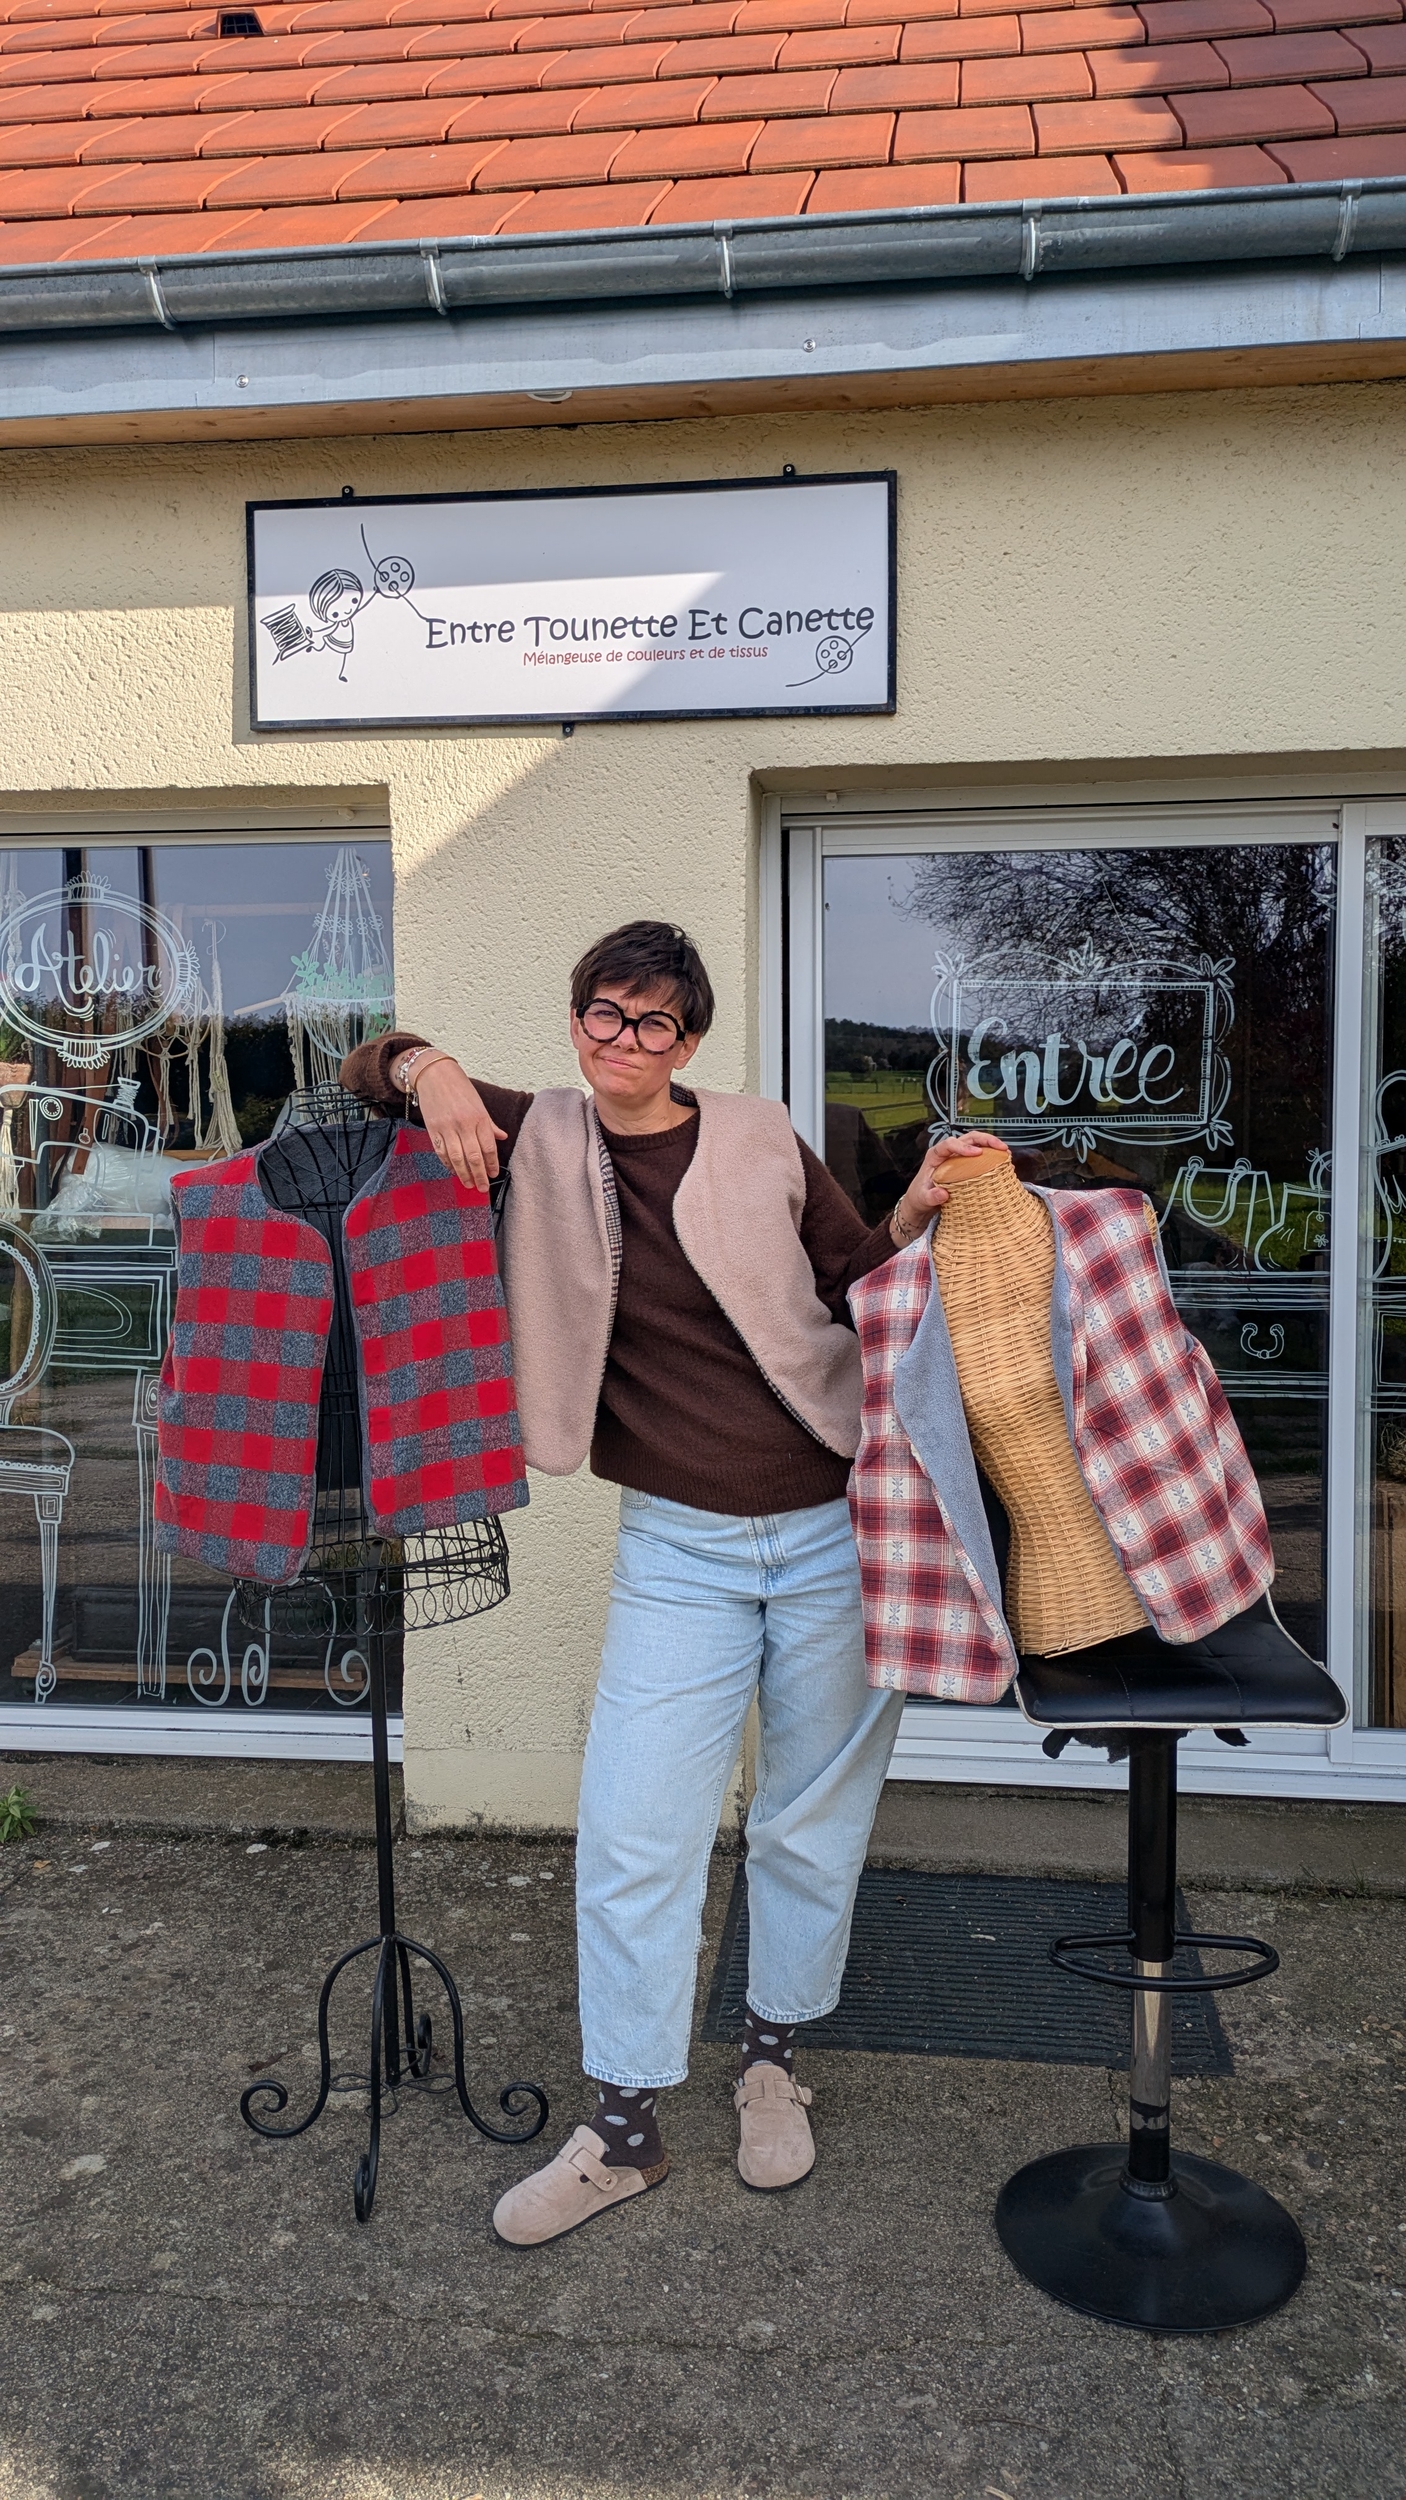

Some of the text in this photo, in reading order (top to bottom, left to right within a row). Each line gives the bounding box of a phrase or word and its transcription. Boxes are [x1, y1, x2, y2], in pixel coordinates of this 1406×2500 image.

[425, 606, 875, 649] Entre Tounette Et Canette
[523, 645, 769, 666] Mélangeuse de couleurs et de tissus
[14, 922, 162, 1013] Atelier
[966, 1010, 1184, 1115] Entrée
